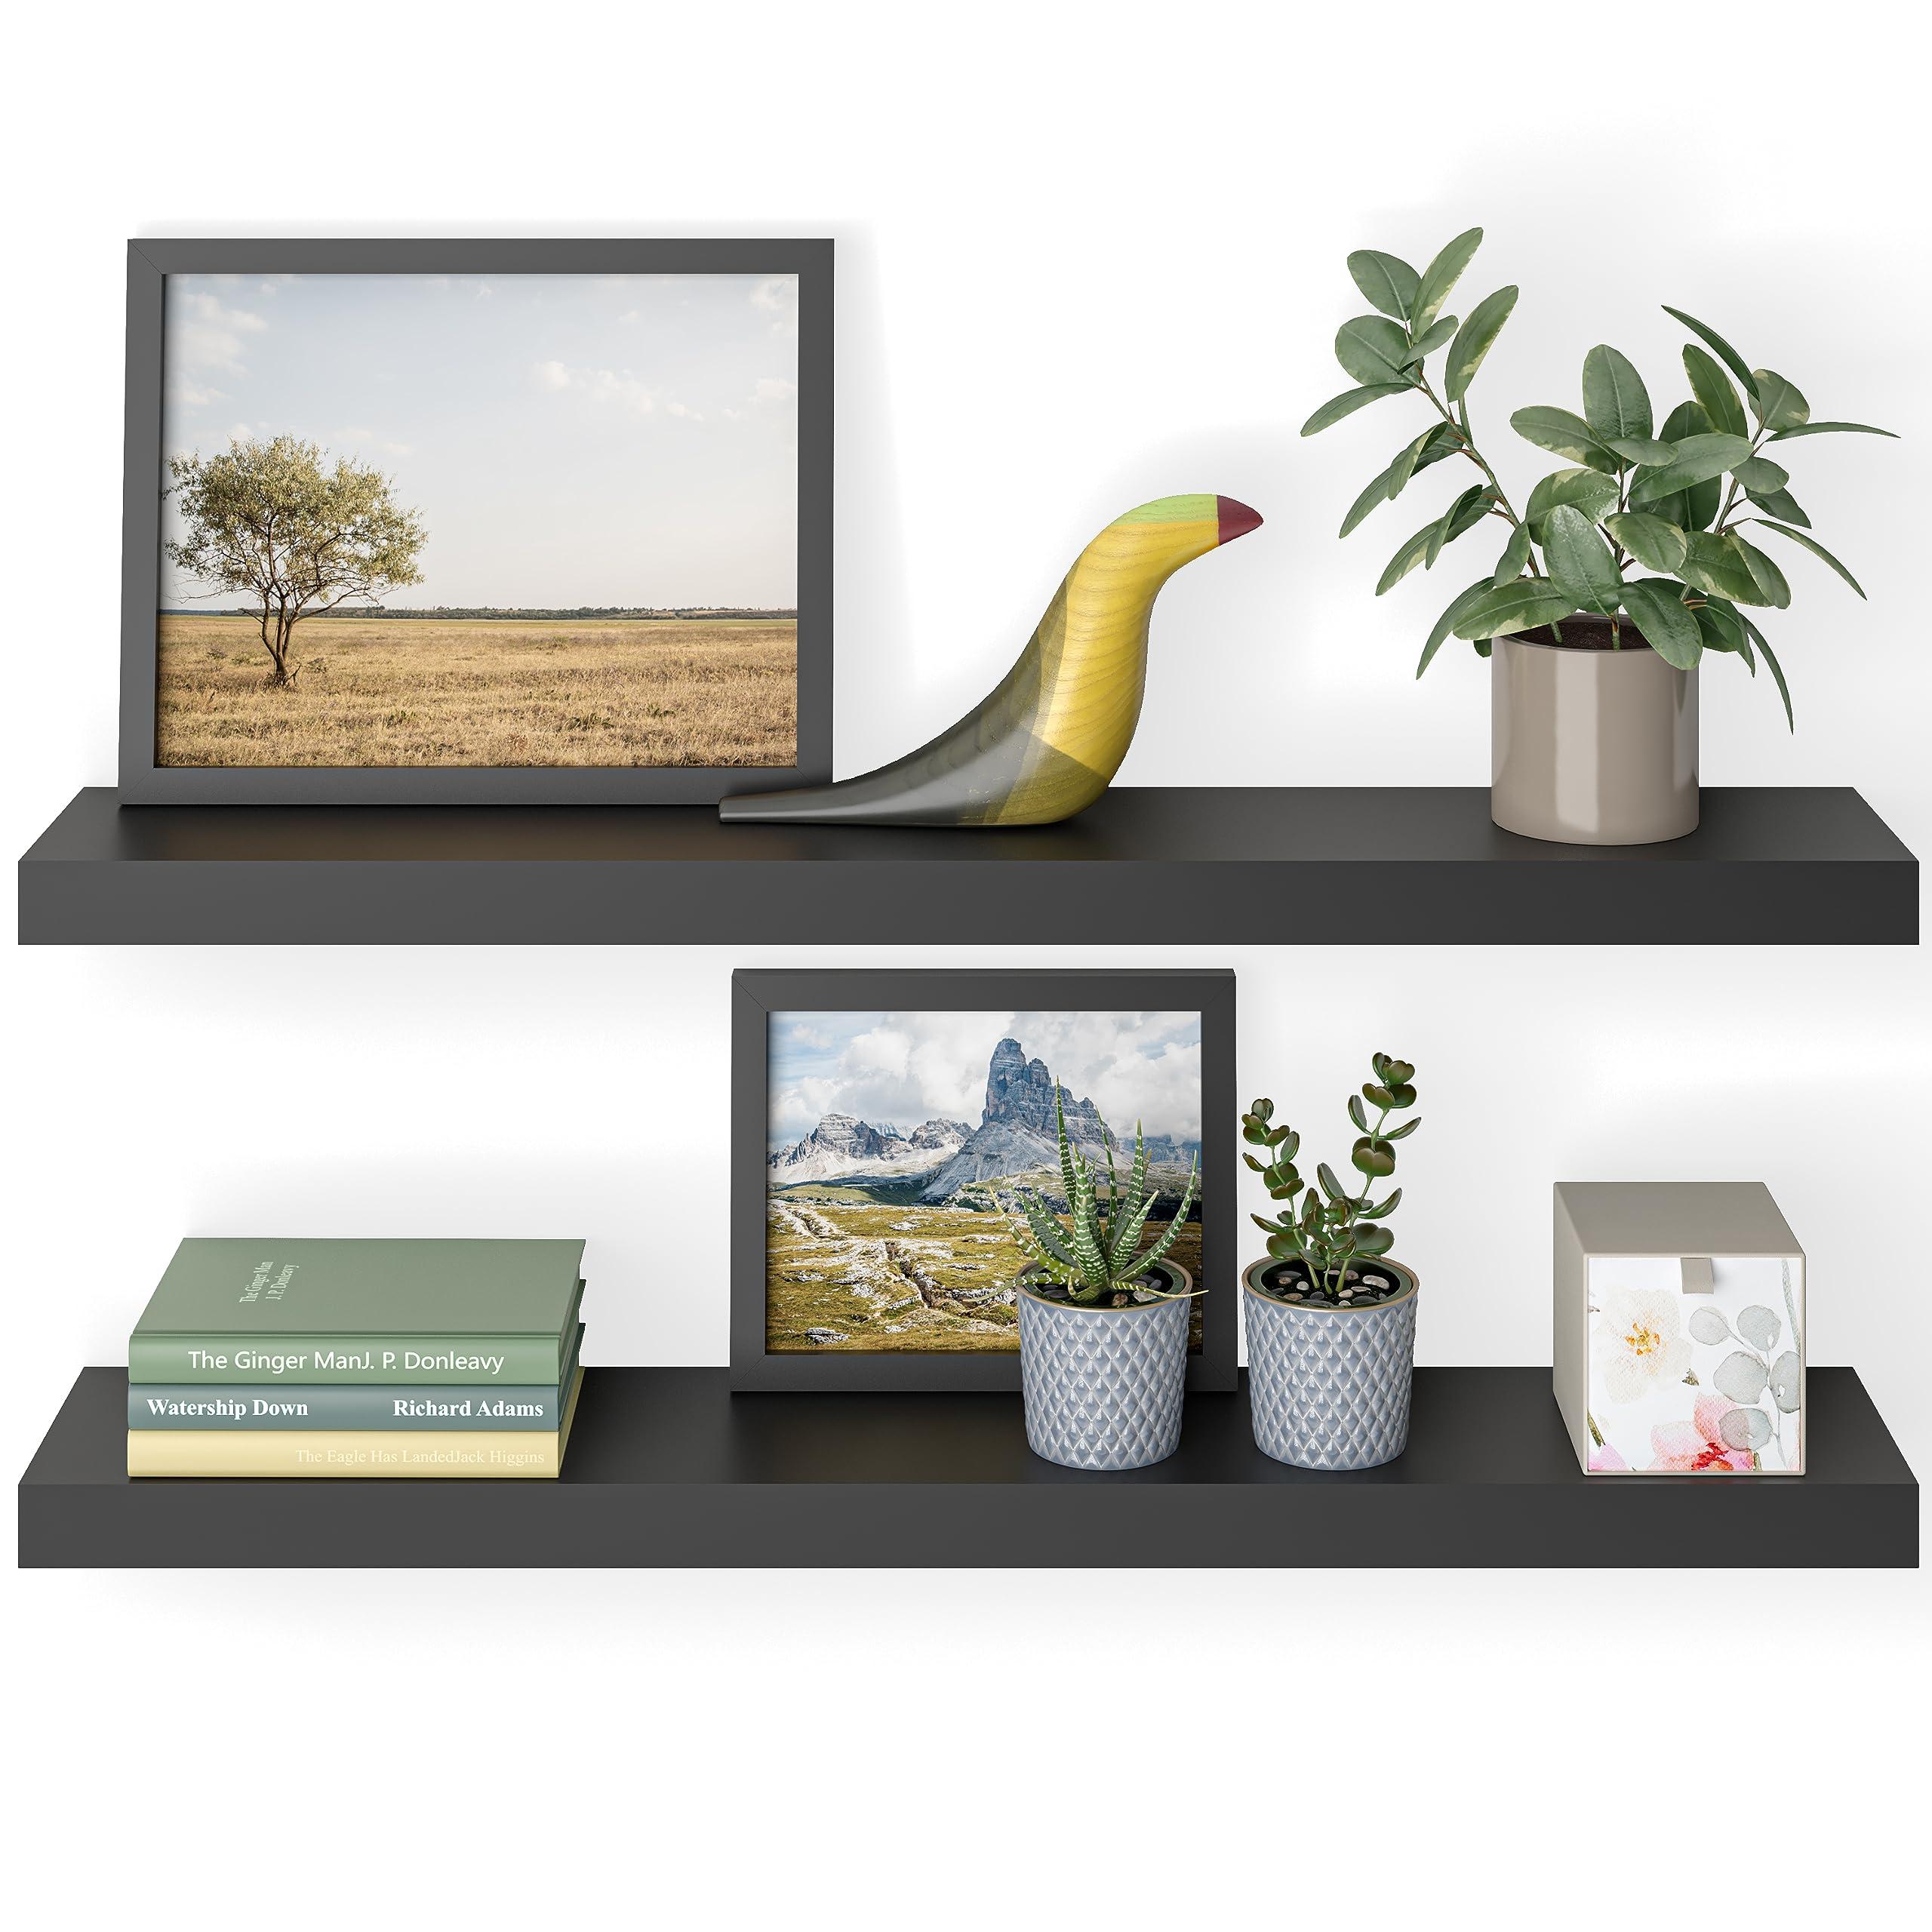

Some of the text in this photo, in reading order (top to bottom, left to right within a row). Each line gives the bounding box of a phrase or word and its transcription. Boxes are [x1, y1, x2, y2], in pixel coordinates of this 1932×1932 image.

[239, 1261, 274, 1303] The Ginger Man
[270, 1264, 300, 1288] Donleavy
[188, 1350, 227, 1370] The
[235, 1350, 307, 1374] Ginger
[383, 1350, 397, 1370] P.
[405, 1350, 504, 1374] Donleavy
[146, 1398, 309, 1420] Watership Down
[392, 1399, 544, 1417] Richard Adams
[295, 1450, 322, 1463] The
[327, 1450, 367, 1466] Eagle
[371, 1450, 398, 1463] Has
[490, 1450, 544, 1467] Higgins
